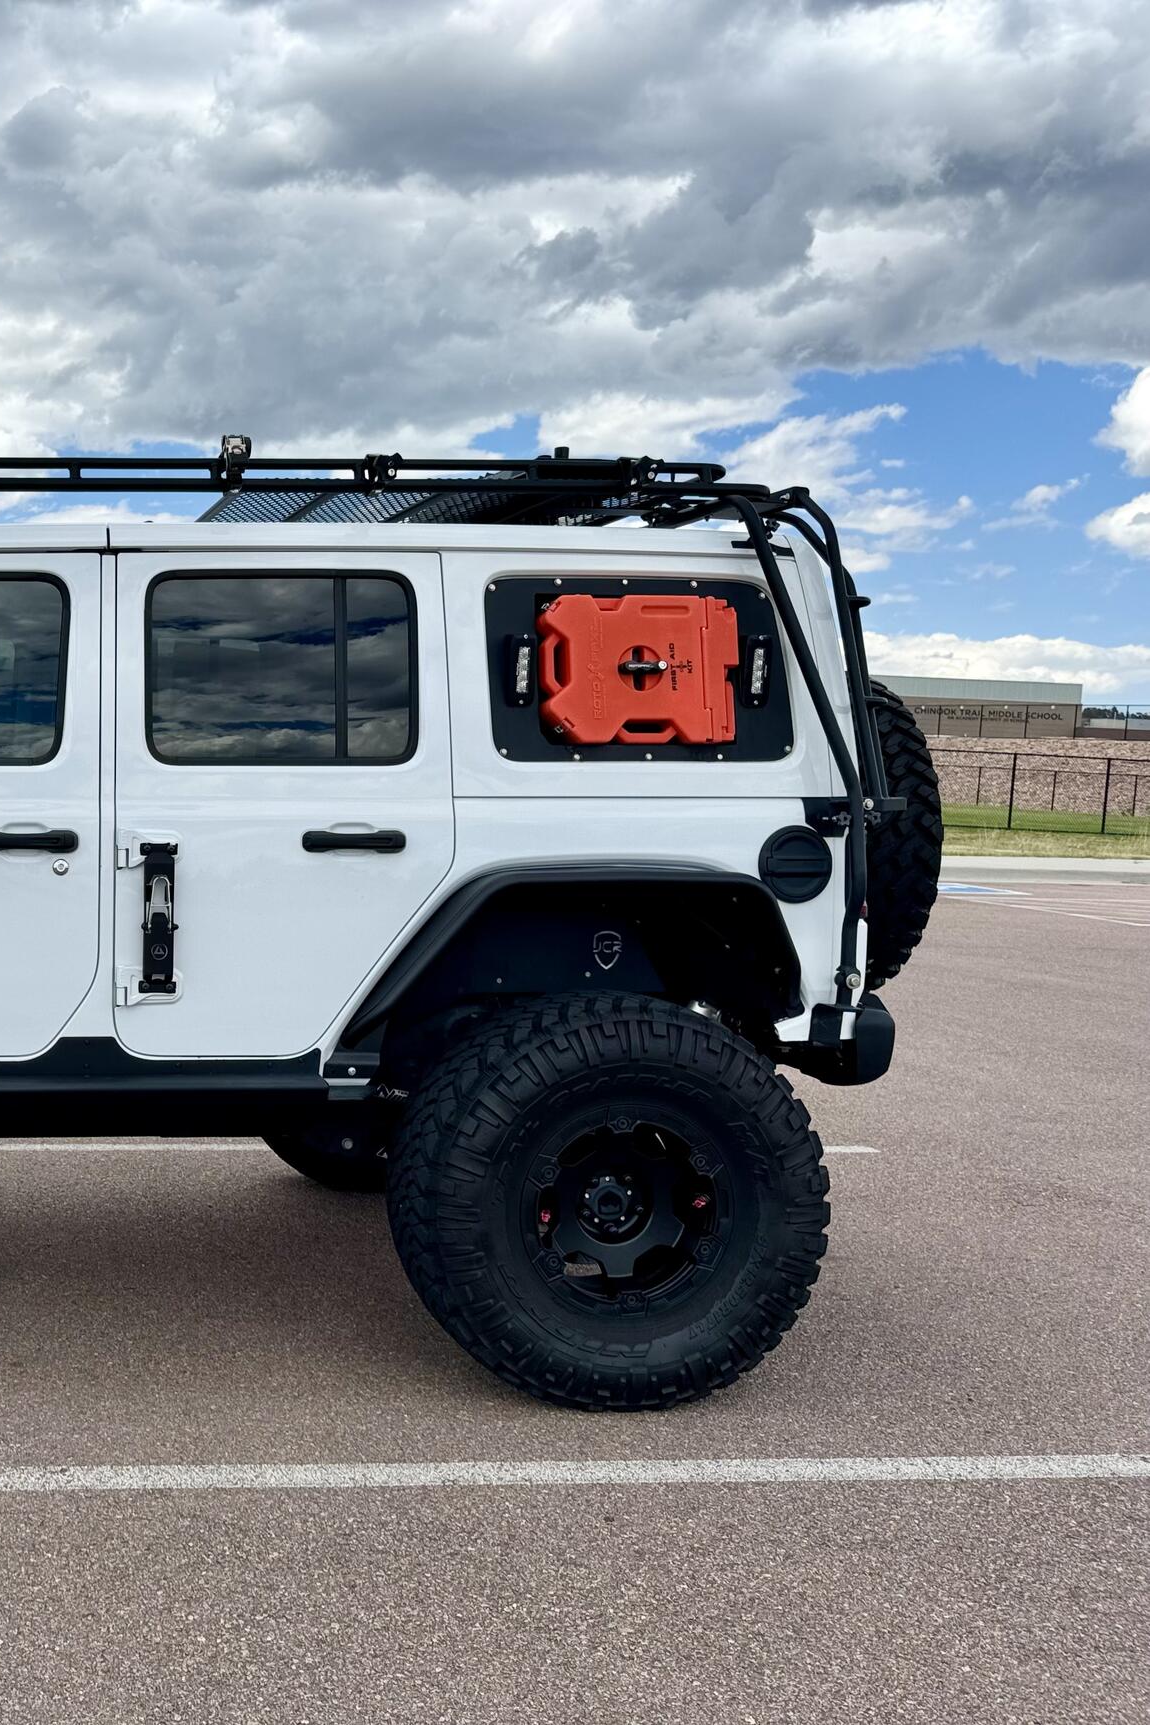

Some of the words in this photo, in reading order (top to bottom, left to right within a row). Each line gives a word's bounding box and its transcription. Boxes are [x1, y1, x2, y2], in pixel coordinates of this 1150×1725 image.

[914, 706, 957, 716] CHINOOK
[959, 708, 986, 717] TRAIL
[988, 710, 1023, 719] MIDDLE
[1025, 711, 1063, 720] SCHOOL
[593, 941, 623, 953] JCR
